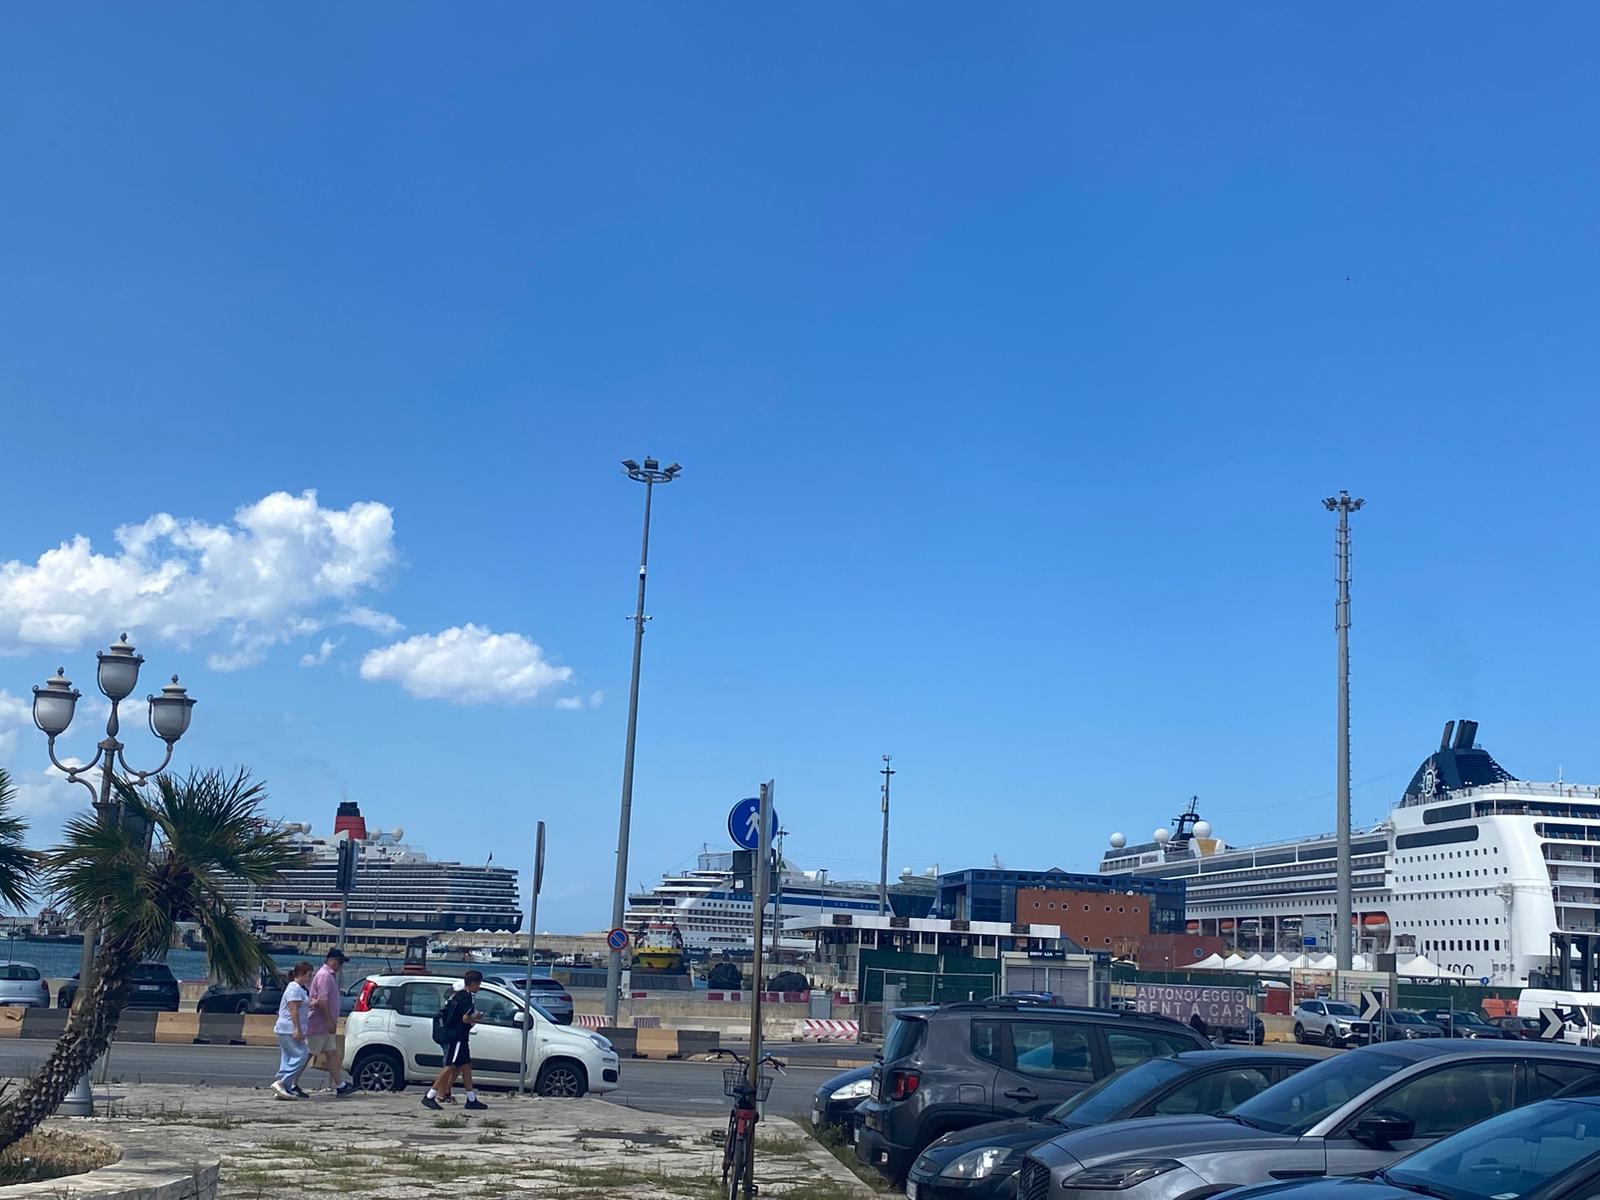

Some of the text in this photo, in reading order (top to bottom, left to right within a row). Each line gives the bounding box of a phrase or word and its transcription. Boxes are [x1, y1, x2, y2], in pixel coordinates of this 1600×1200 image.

[1138, 987, 1244, 1003] AUTONOLEGGIO
[1137, 1000, 1245, 1018] RENT A CAR
